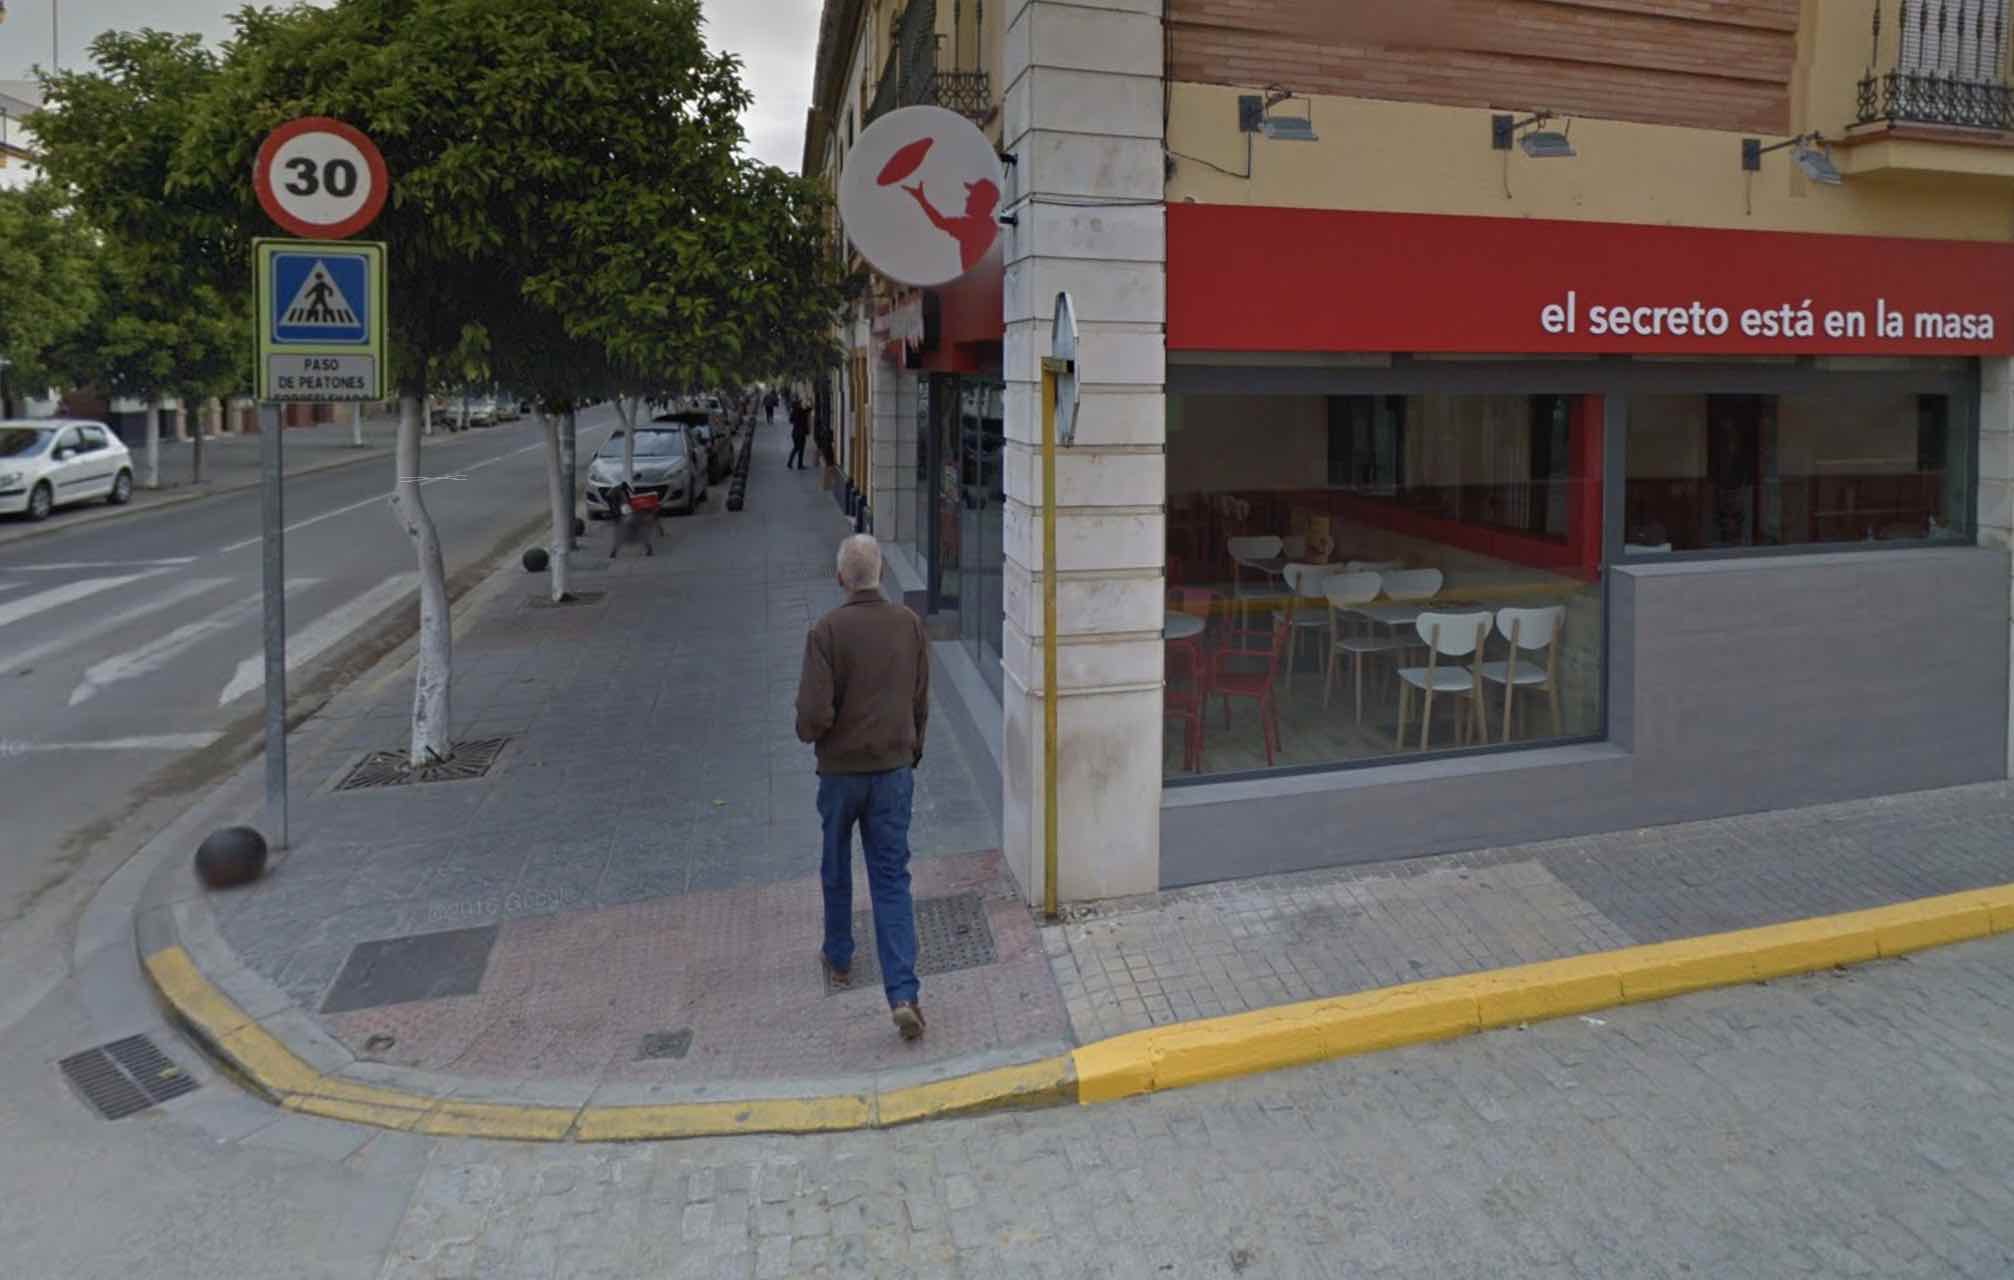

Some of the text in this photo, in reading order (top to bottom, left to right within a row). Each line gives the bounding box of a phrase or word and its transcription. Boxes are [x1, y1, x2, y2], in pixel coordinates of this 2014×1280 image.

[285, 157, 357, 197] 30
[1541, 290, 1994, 340] el secreto está en la masa
[304, 358, 339, 371] PASO
[278, 376, 364, 389] DE PEATONES
